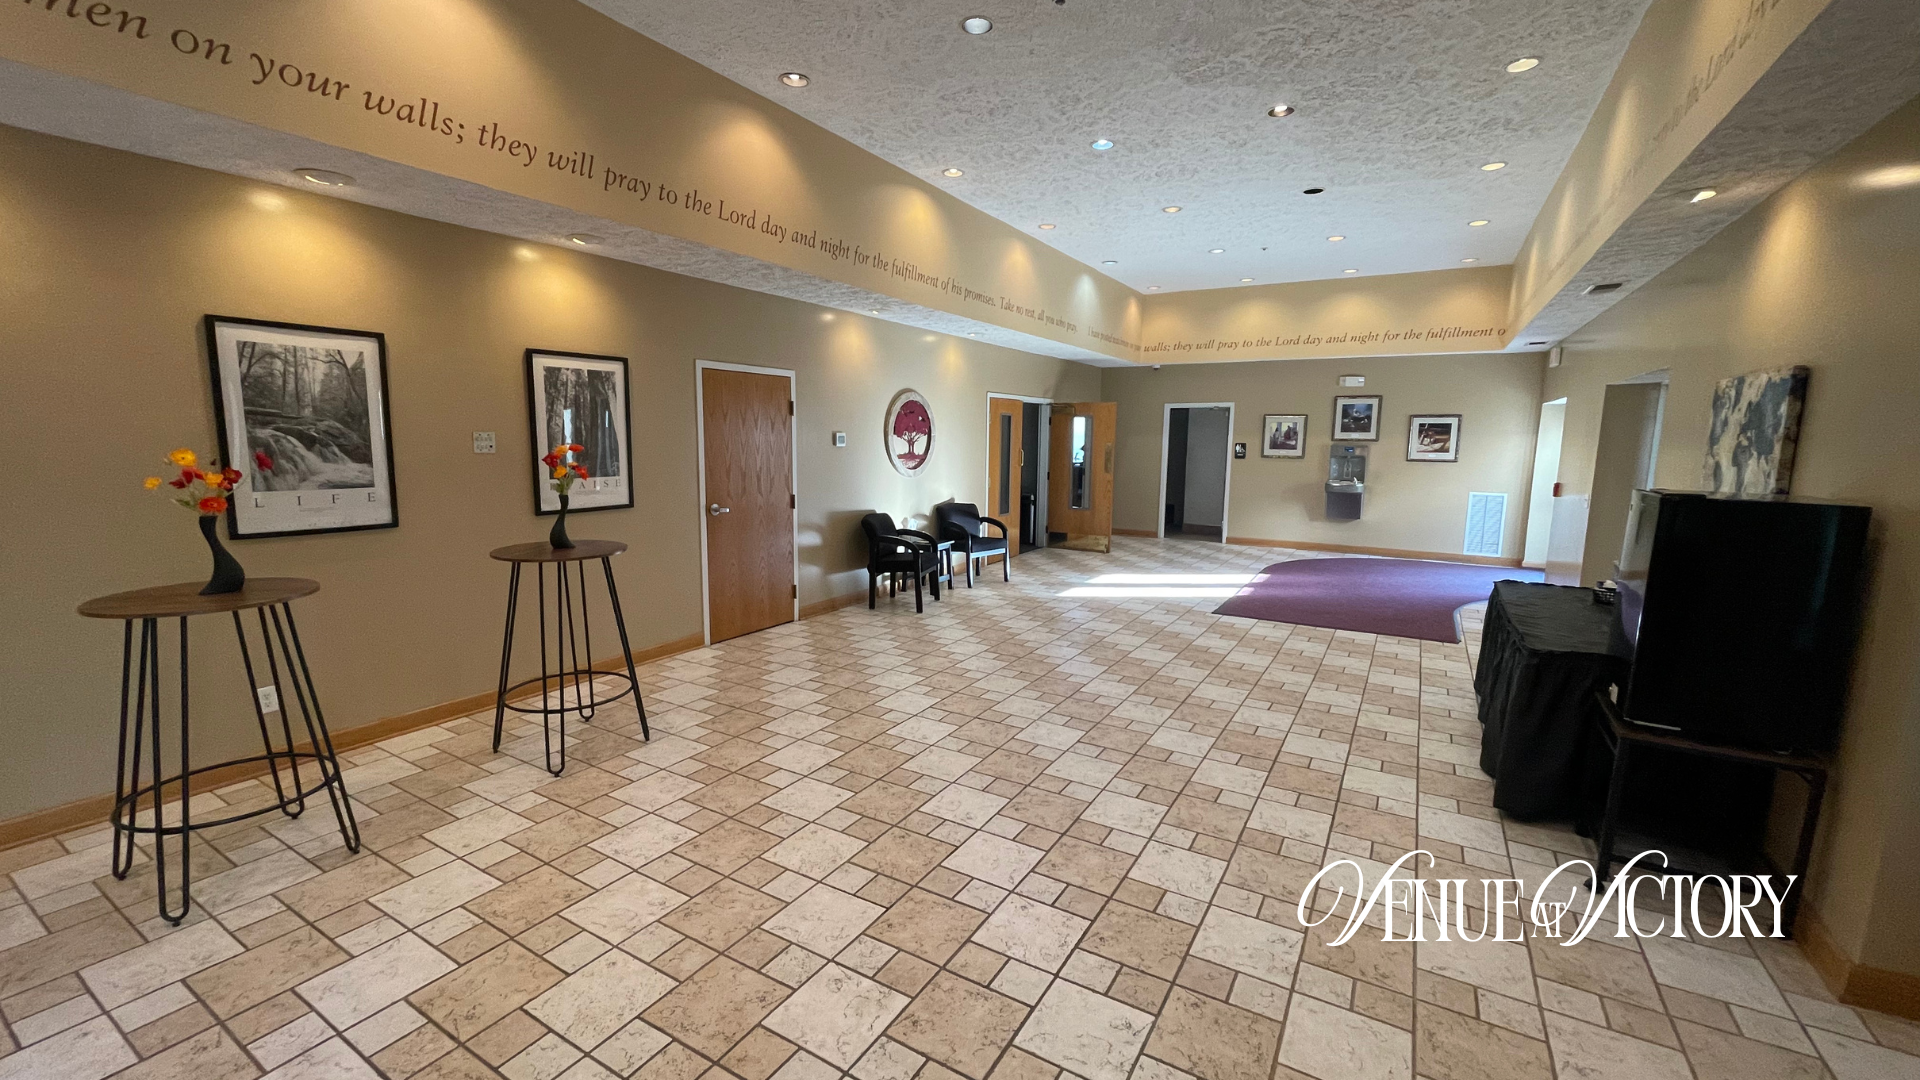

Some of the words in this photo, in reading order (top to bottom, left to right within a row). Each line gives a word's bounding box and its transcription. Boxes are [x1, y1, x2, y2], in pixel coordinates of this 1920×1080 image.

[171, 29, 232, 65] on
[250, 53, 350, 100] your
[363, 91, 465, 144] walls;
[478, 123, 537, 167] they
[548, 151, 594, 179] will
[604, 167, 651, 201] pray
[658, 184, 678, 205] to
[685, 190, 712, 215] the
[718, 200, 756, 230] Lord
[761, 215, 787, 243] day
[791, 231, 816, 249] and
[820, 238, 850, 261] night
[853, 245, 870, 266] for
[872, 252, 889, 272] the
[891, 258, 939, 288] fulfillment
[941, 277, 951, 295] of
[951, 278, 962, 296] his
[964, 287, 996, 307] promises.
[1000, 296, 1015, 312] Take
[1037, 309, 1045, 321] all
[1144, 342, 1170, 352] walls;
[1173, 341, 1194, 352] they
[1196, 339, 1215, 350] will
[1217, 339, 1239, 351] pray
[1242, 339, 1253, 348] to
[1256, 336, 1272, 347] the
[1275, 335, 1301, 346] Lord
[1303, 334, 1323, 346] day
[1326, 333, 1347, 343] and
[1350, 332, 1379, 345] night
[1382, 330, 1400, 343] for
[1403, 329, 1422, 340] the
[1425, 327, 1493, 341] fulfillment
[550, 479, 621, 491] AISE
[254, 492, 376, 508] LIFE
